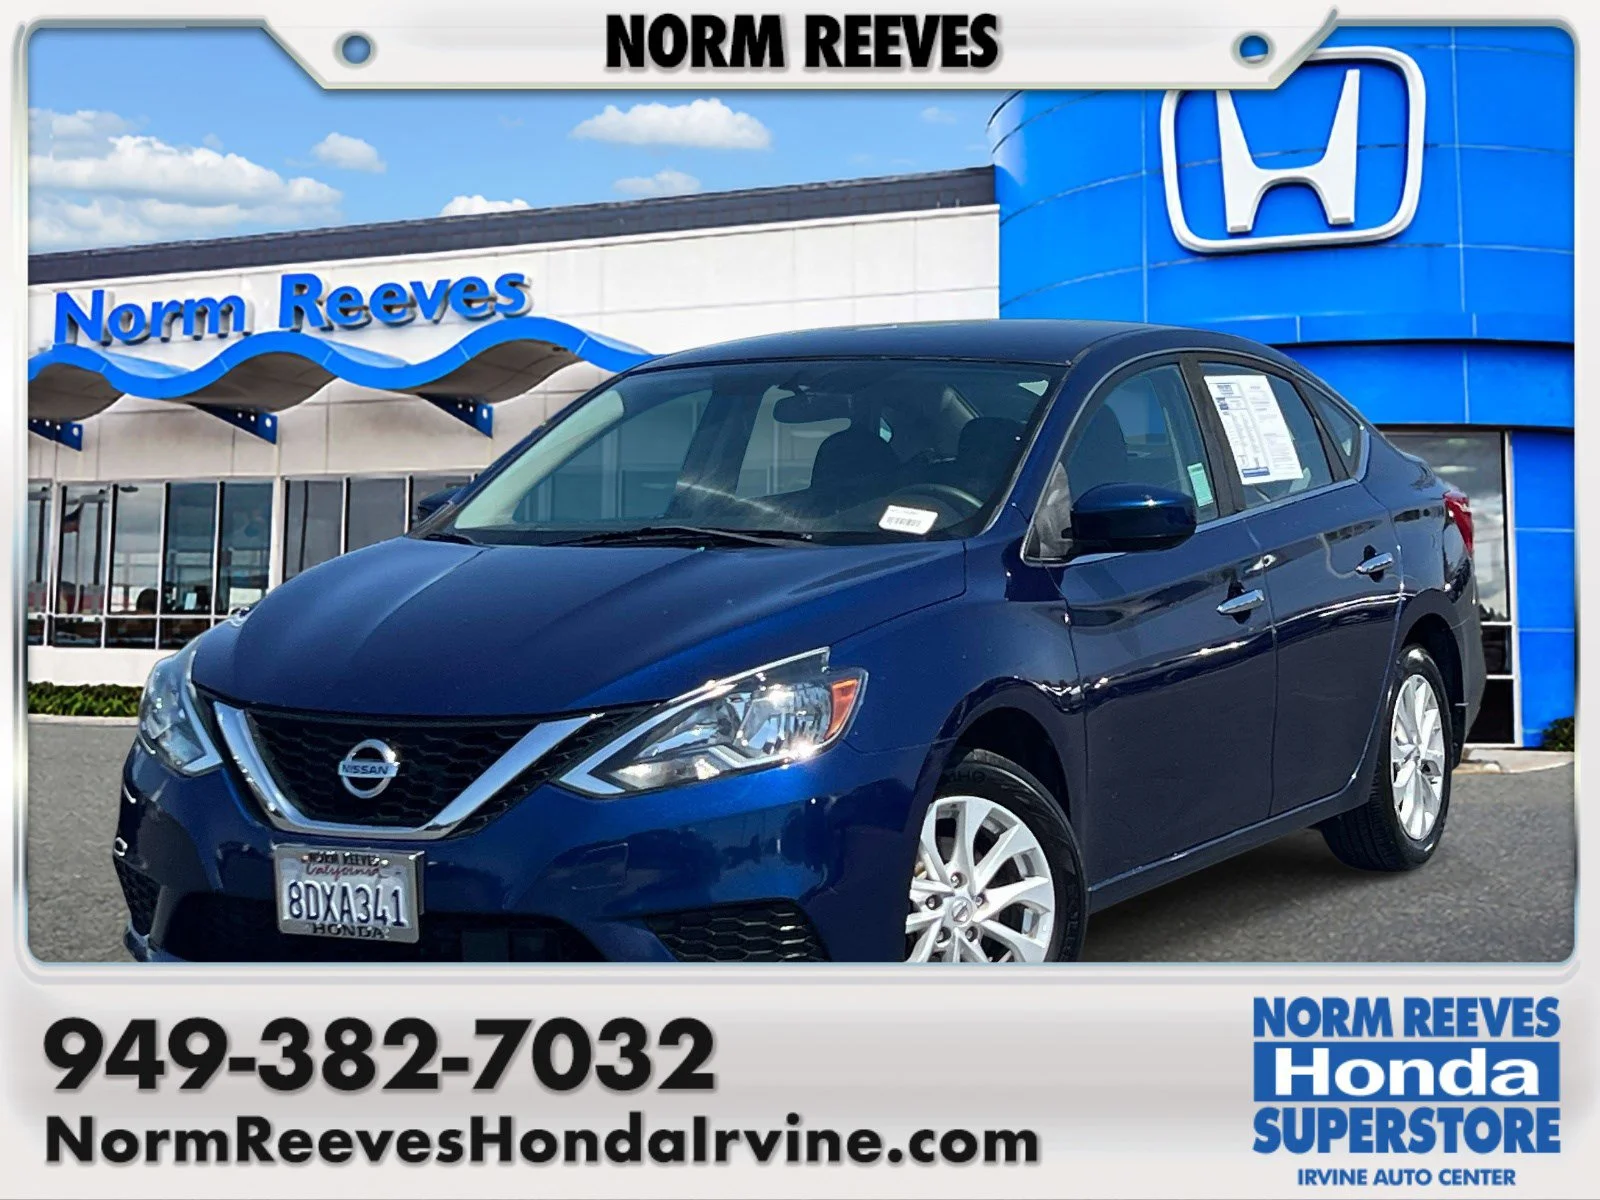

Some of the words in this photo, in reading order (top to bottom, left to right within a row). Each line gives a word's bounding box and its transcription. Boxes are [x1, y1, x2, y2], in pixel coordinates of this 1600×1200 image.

[55, 289, 246, 344] Norm
[279, 272, 529, 330] Reeves
[342, 764, 389, 775] NISSAN
[306, 864, 381, 881] California
[288, 881, 405, 927] 8DXA341
[312, 924, 385, 939] HONDA
